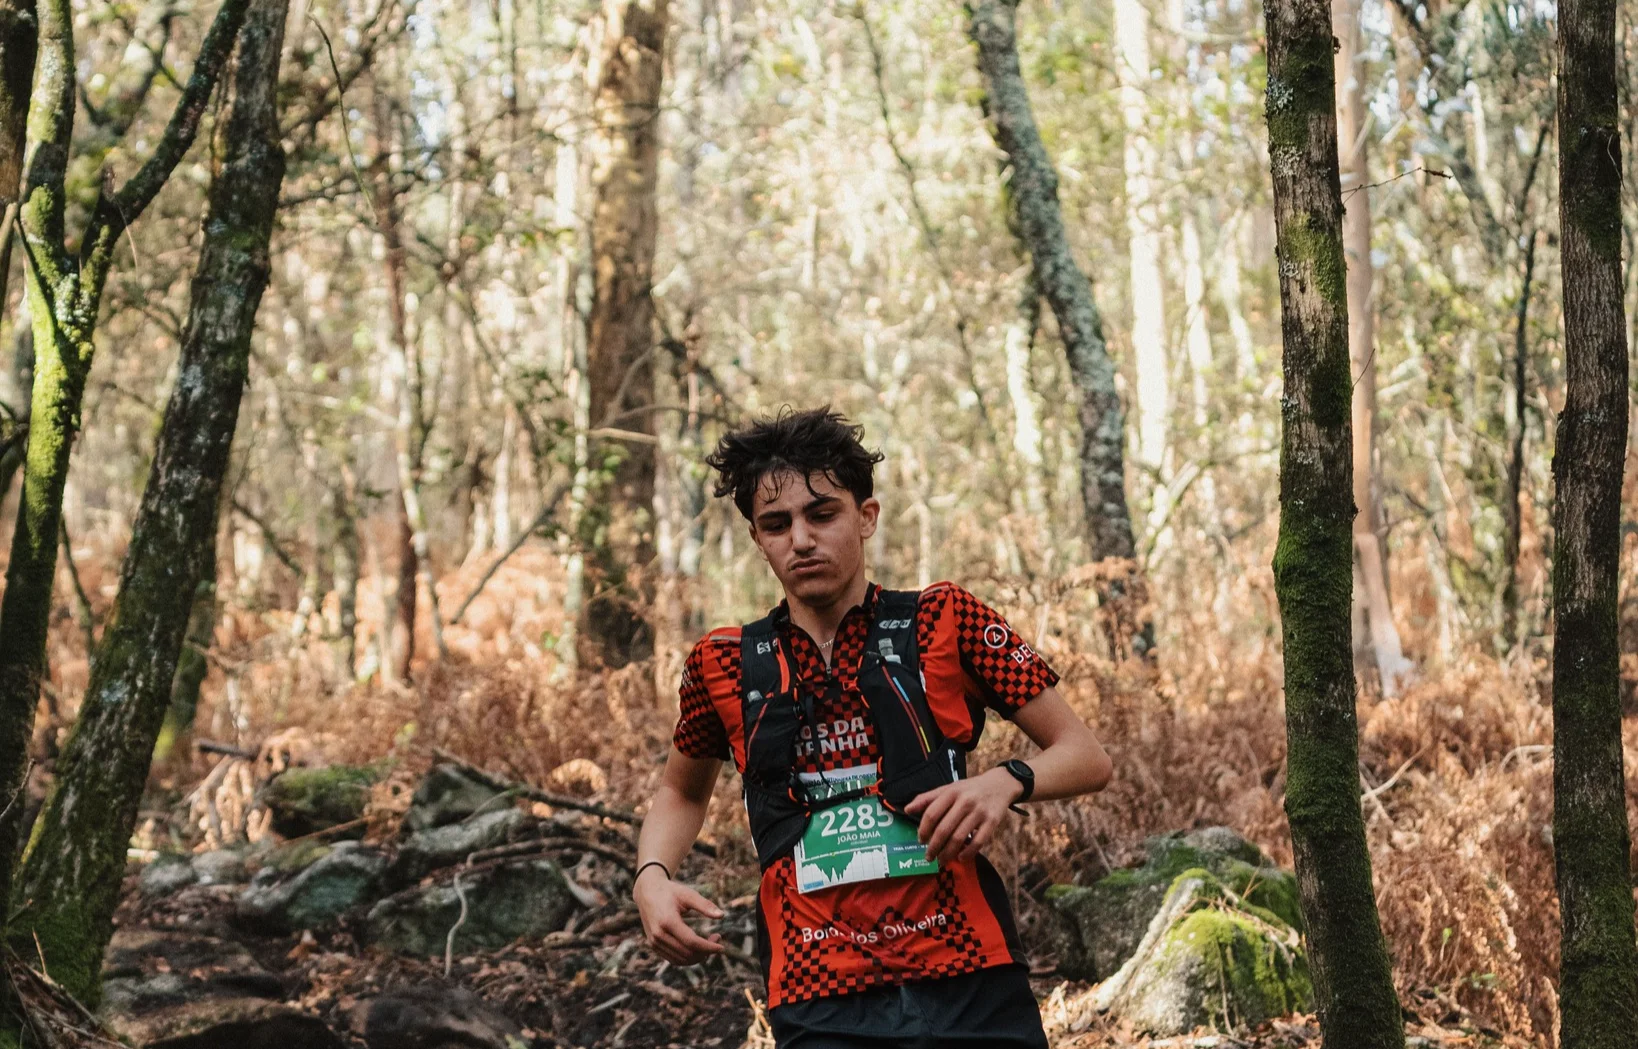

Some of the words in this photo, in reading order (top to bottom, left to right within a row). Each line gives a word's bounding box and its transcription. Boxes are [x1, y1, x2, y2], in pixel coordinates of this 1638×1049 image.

[833, 716, 865, 736] DA
[820, 803, 894, 837] 2285
[837, 833, 857, 845] JOÃO
[859, 830, 881, 840] MAIA
[883, 913, 947, 940] Oliveira
